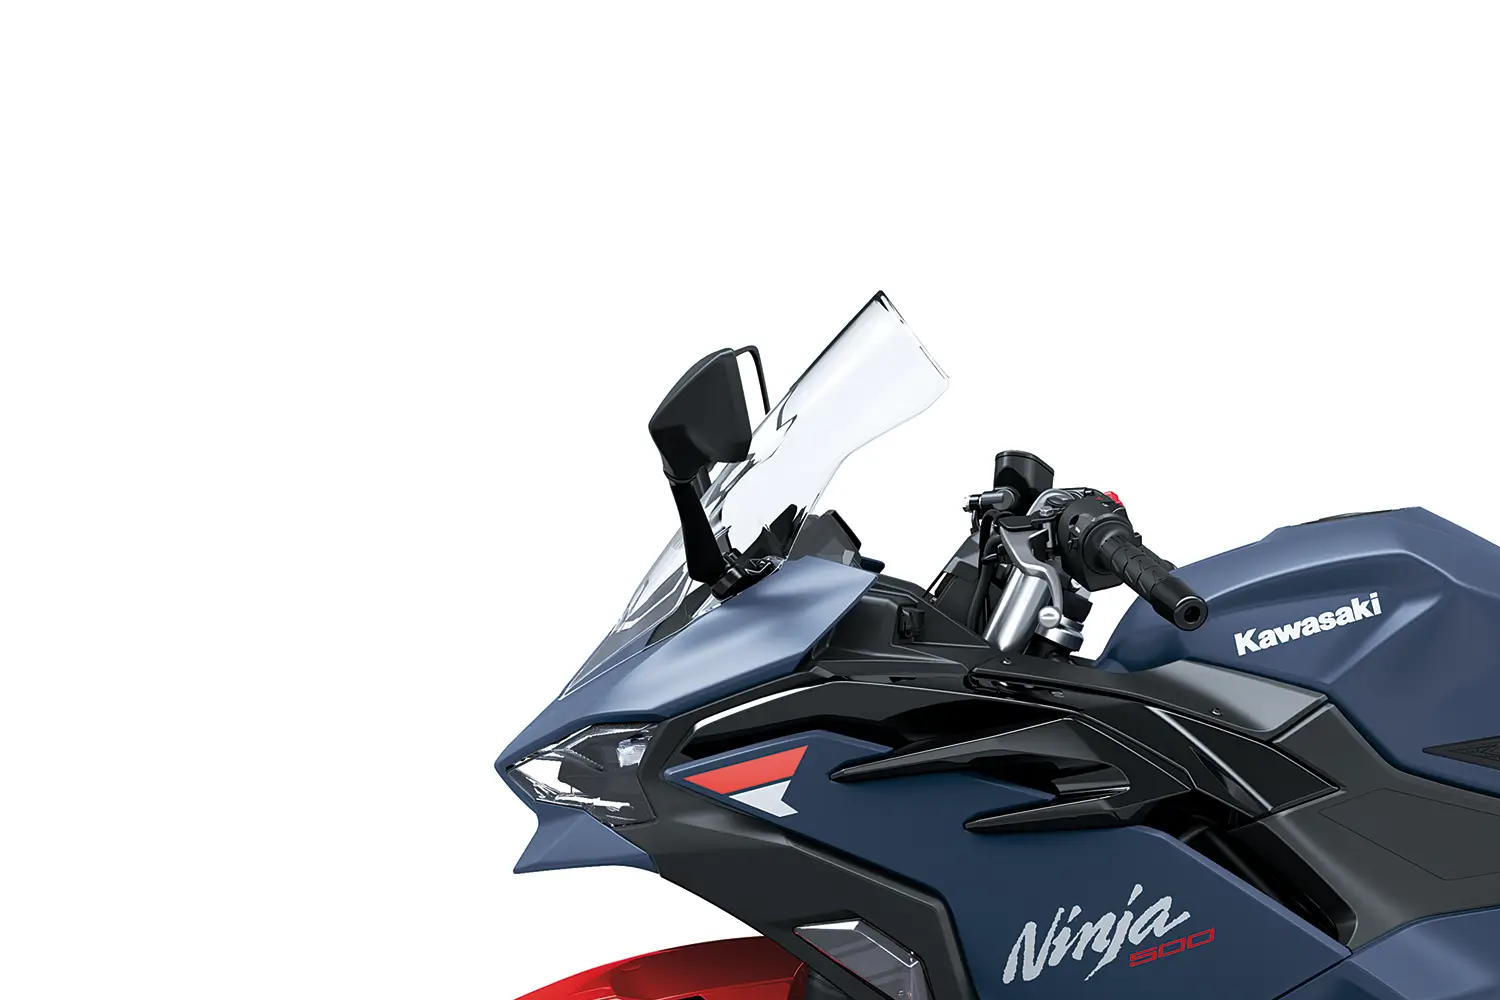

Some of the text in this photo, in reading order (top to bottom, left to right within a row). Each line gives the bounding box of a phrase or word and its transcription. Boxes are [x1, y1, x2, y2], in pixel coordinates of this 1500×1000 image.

[1233, 591, 1383, 657] Kawasaki
[1002, 883, 1191, 984] Ninja
[1129, 927, 1215, 967] 500
